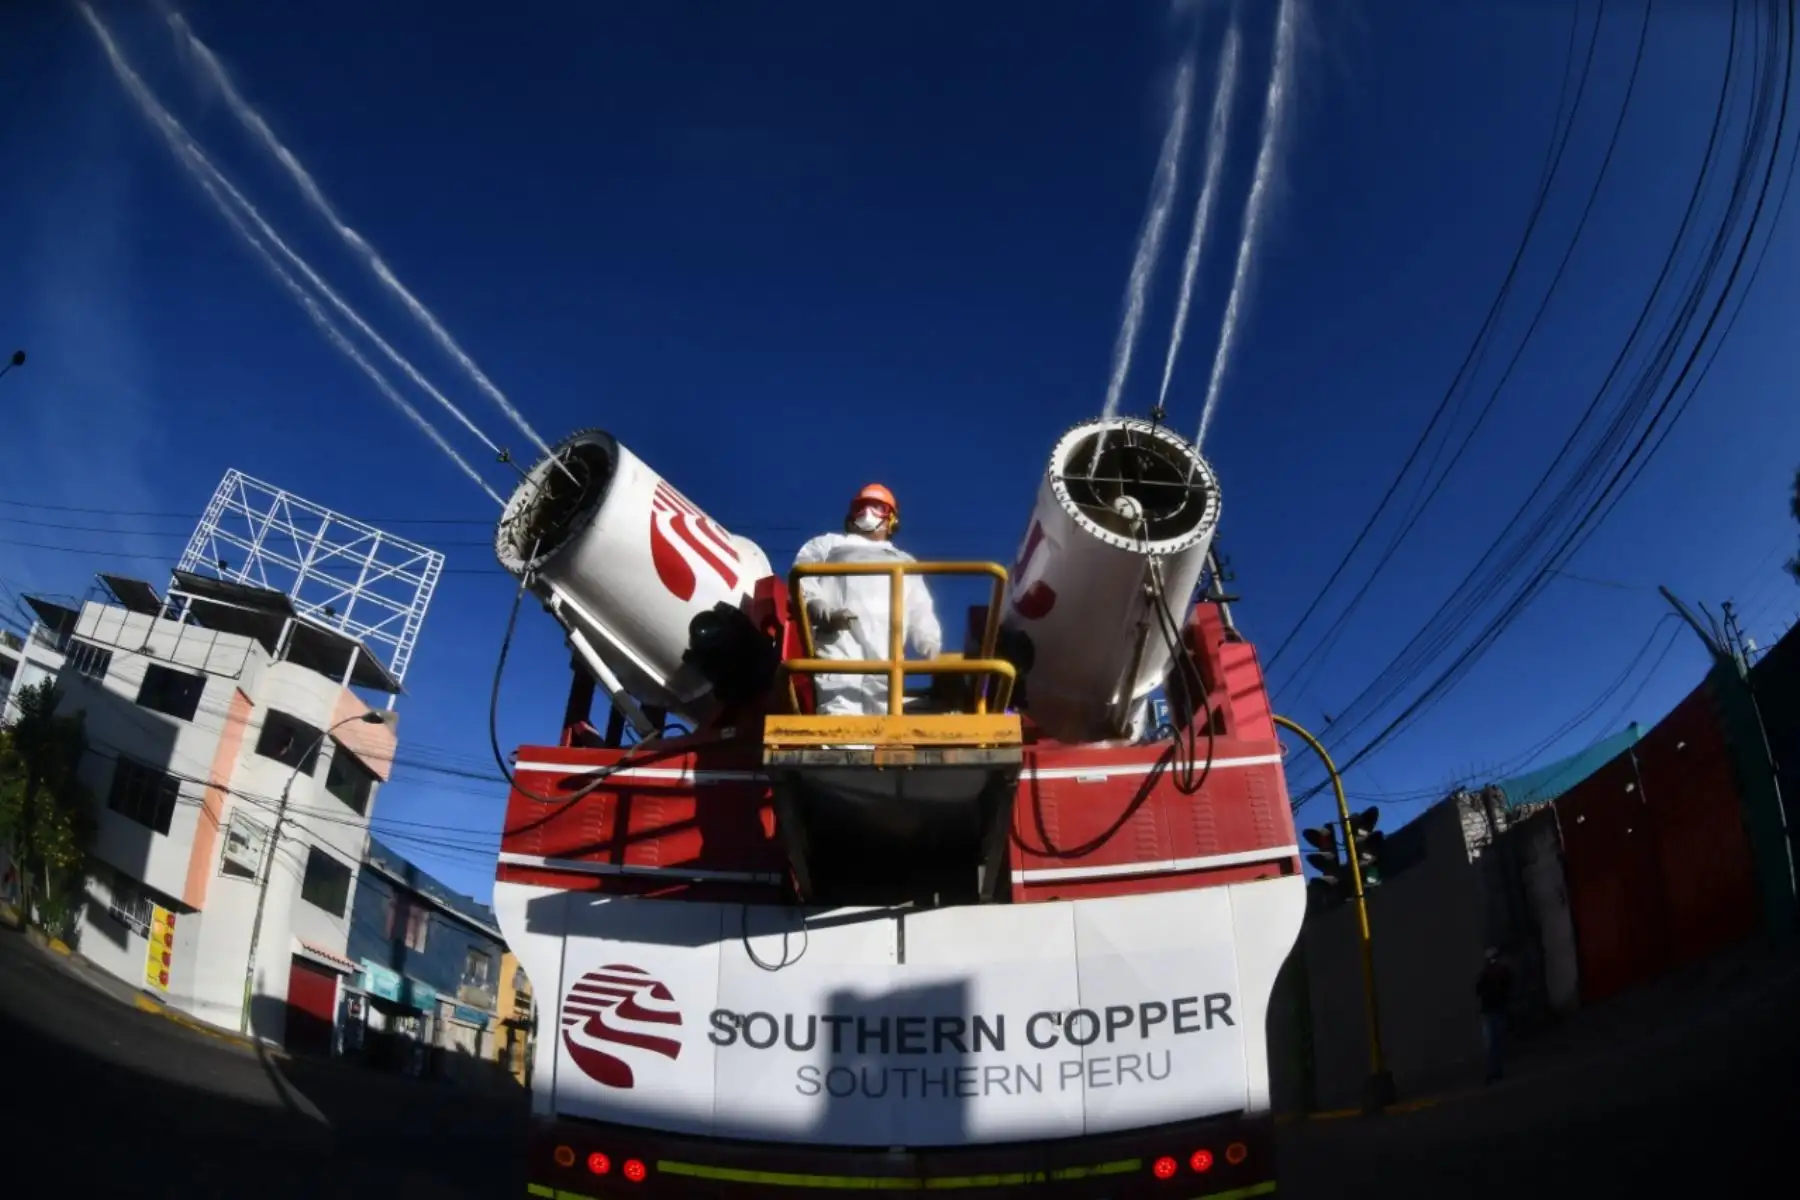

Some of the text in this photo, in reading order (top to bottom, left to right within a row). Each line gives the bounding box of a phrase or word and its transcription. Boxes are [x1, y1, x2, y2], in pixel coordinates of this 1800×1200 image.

[706, 992, 1236, 1055] SOUTHERN COPPER
[795, 1049, 1171, 1099] SOUTHERN PERU
